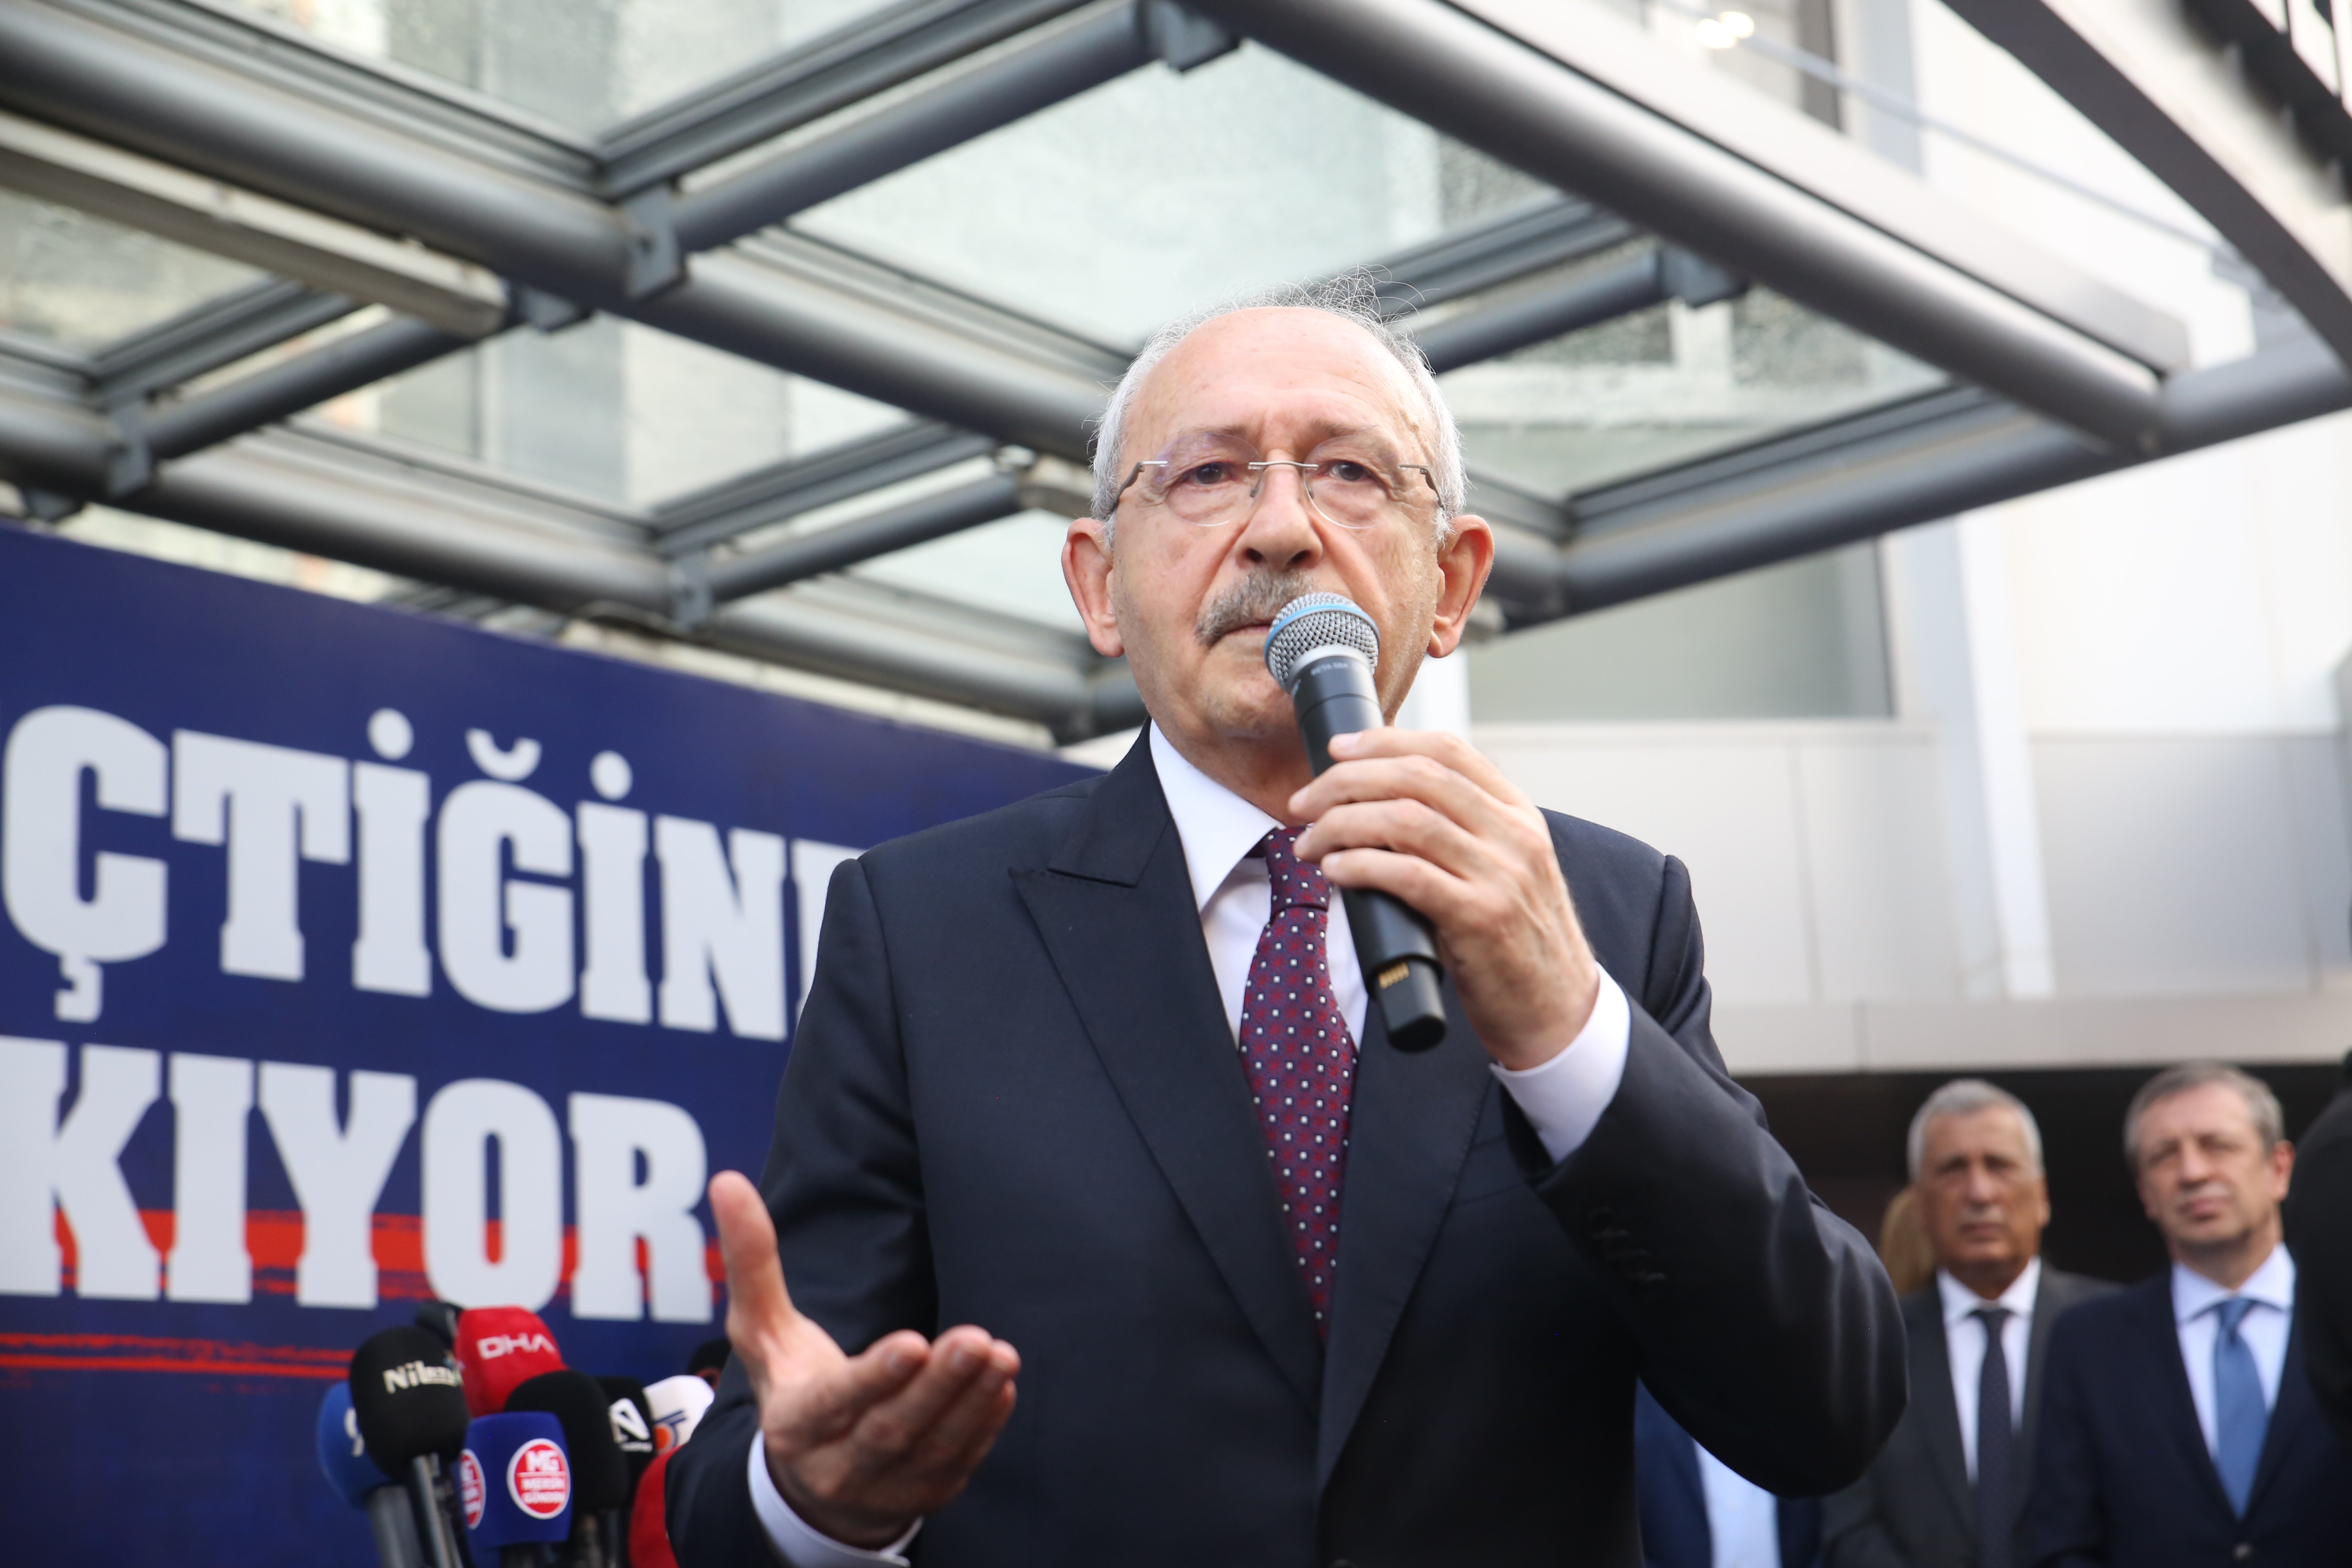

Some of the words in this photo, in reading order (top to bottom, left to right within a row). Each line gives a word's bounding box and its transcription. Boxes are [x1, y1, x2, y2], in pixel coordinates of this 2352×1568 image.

[0, 1035, 713, 1324] KIYOR
[476, 1332, 556, 1360] DHA
[525, 1449, 561, 1471] MG
